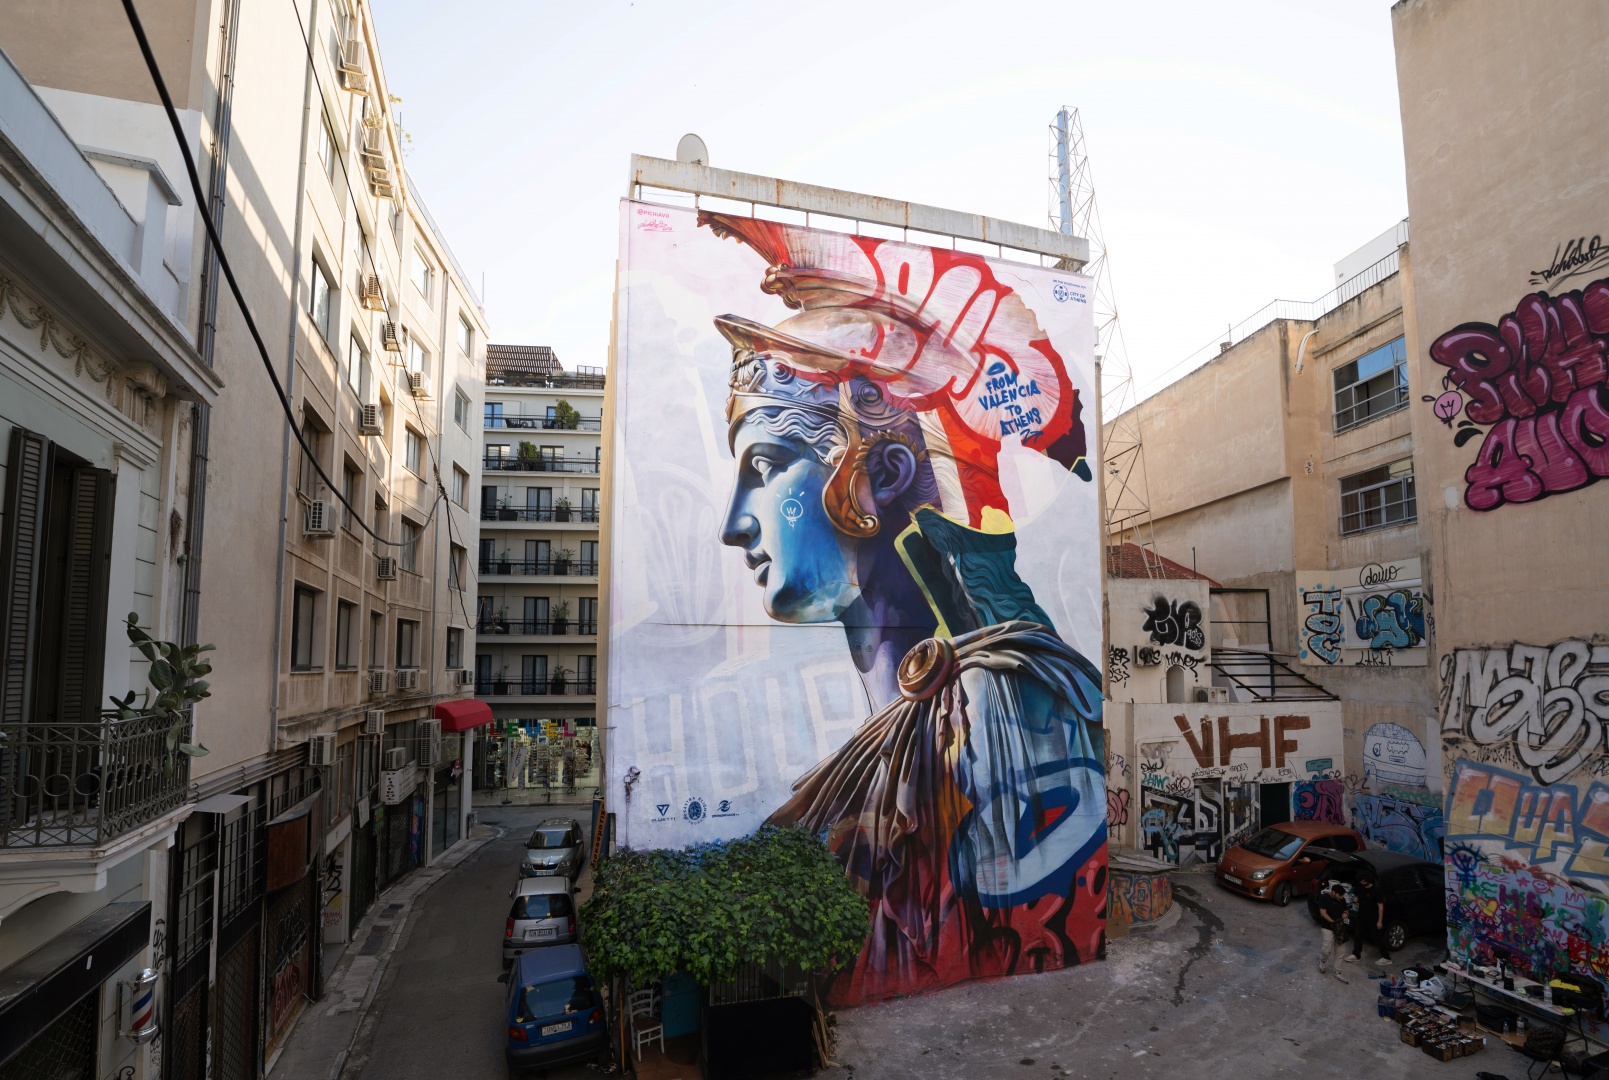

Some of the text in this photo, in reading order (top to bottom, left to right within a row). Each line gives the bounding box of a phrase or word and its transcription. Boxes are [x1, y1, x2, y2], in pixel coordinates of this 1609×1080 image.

[978, 380, 1041, 411] VALENCIA
[985, 371, 1018, 394] FROM
[1000, 407, 1042, 437] ATHENS
[1004, 404, 1023, 416] TO
[488, 722, 577, 738] LEVEL
[1173, 713, 1311, 768] VHF
